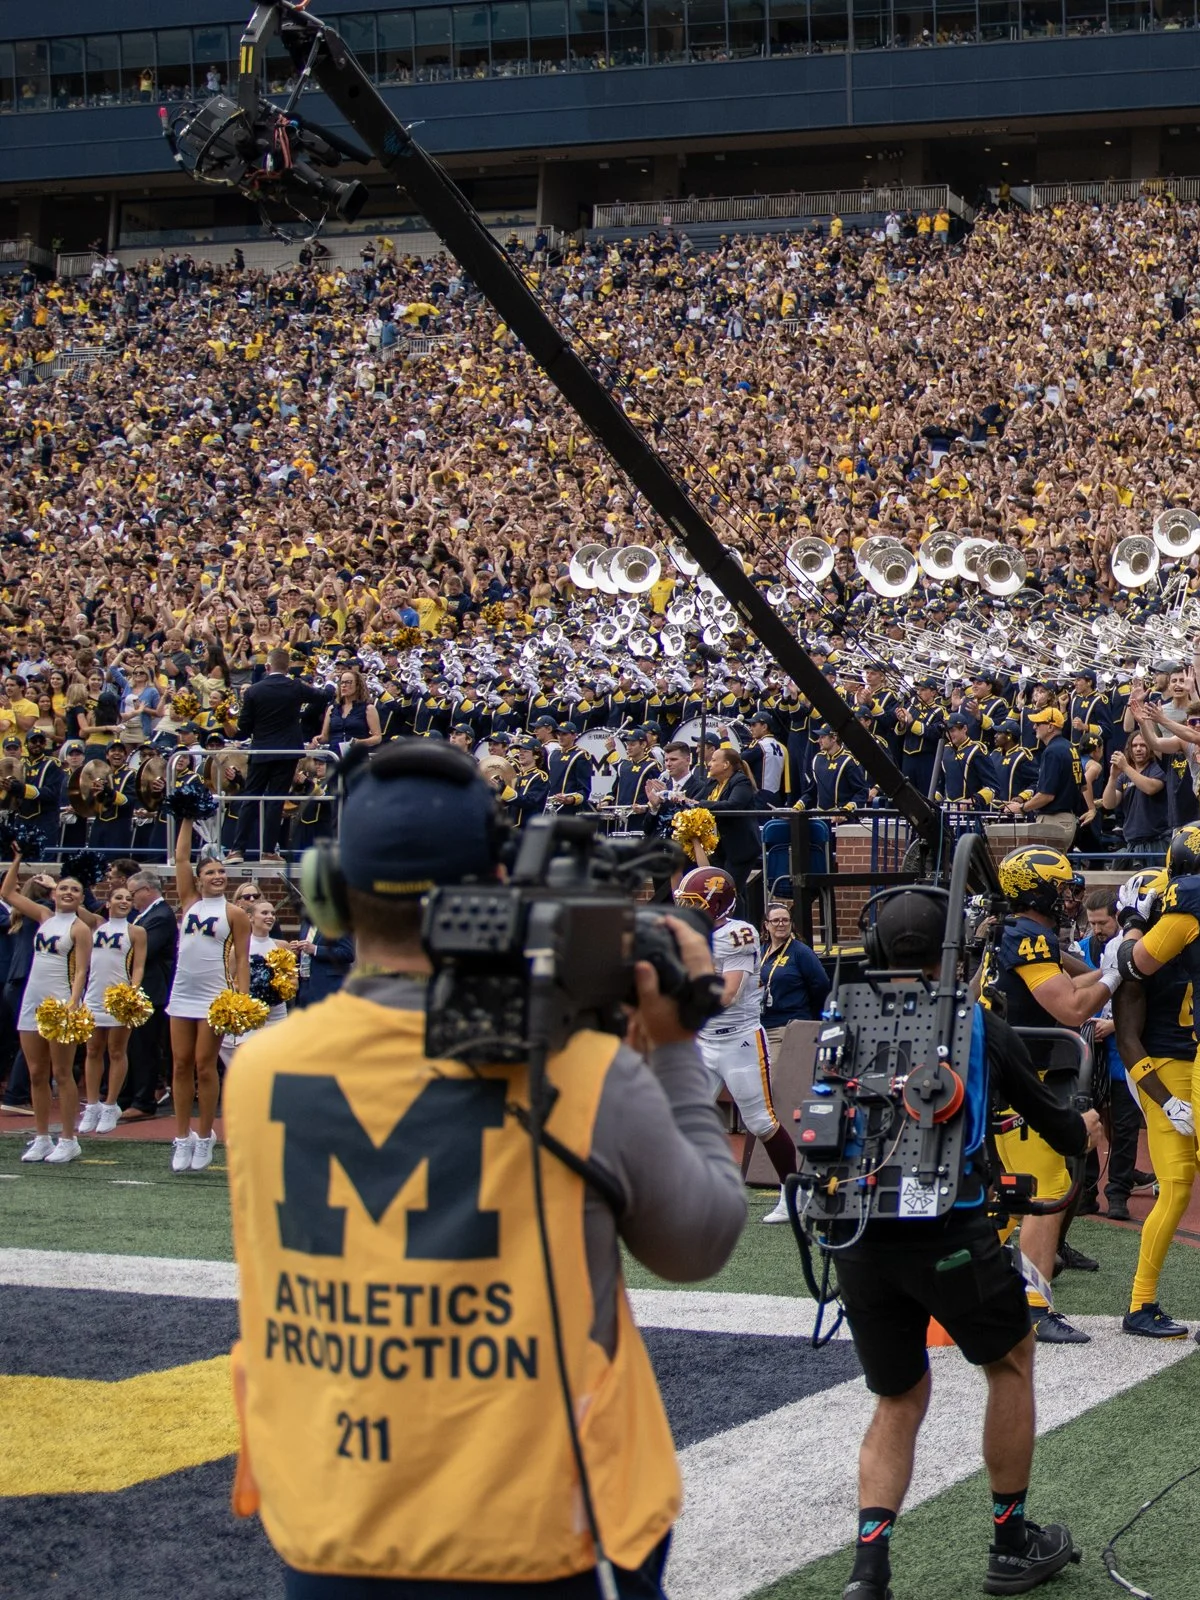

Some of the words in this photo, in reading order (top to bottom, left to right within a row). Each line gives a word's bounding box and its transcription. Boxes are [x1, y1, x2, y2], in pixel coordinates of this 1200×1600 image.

[770, 743, 784, 757] M
[184, 914, 219, 937] M
[729, 927, 755, 947] 12
[35, 933, 60, 953] M
[94, 931, 123, 949] M
[1018, 935, 1052, 961] 44
[1141, 1062, 1152, 1072] M
[269, 1072, 508, 1260] M
[275, 1271, 514, 1326] ATHLETICS
[264, 1318, 539, 1381] PRODUCTION
[335, 1411, 392, 1463] 211
